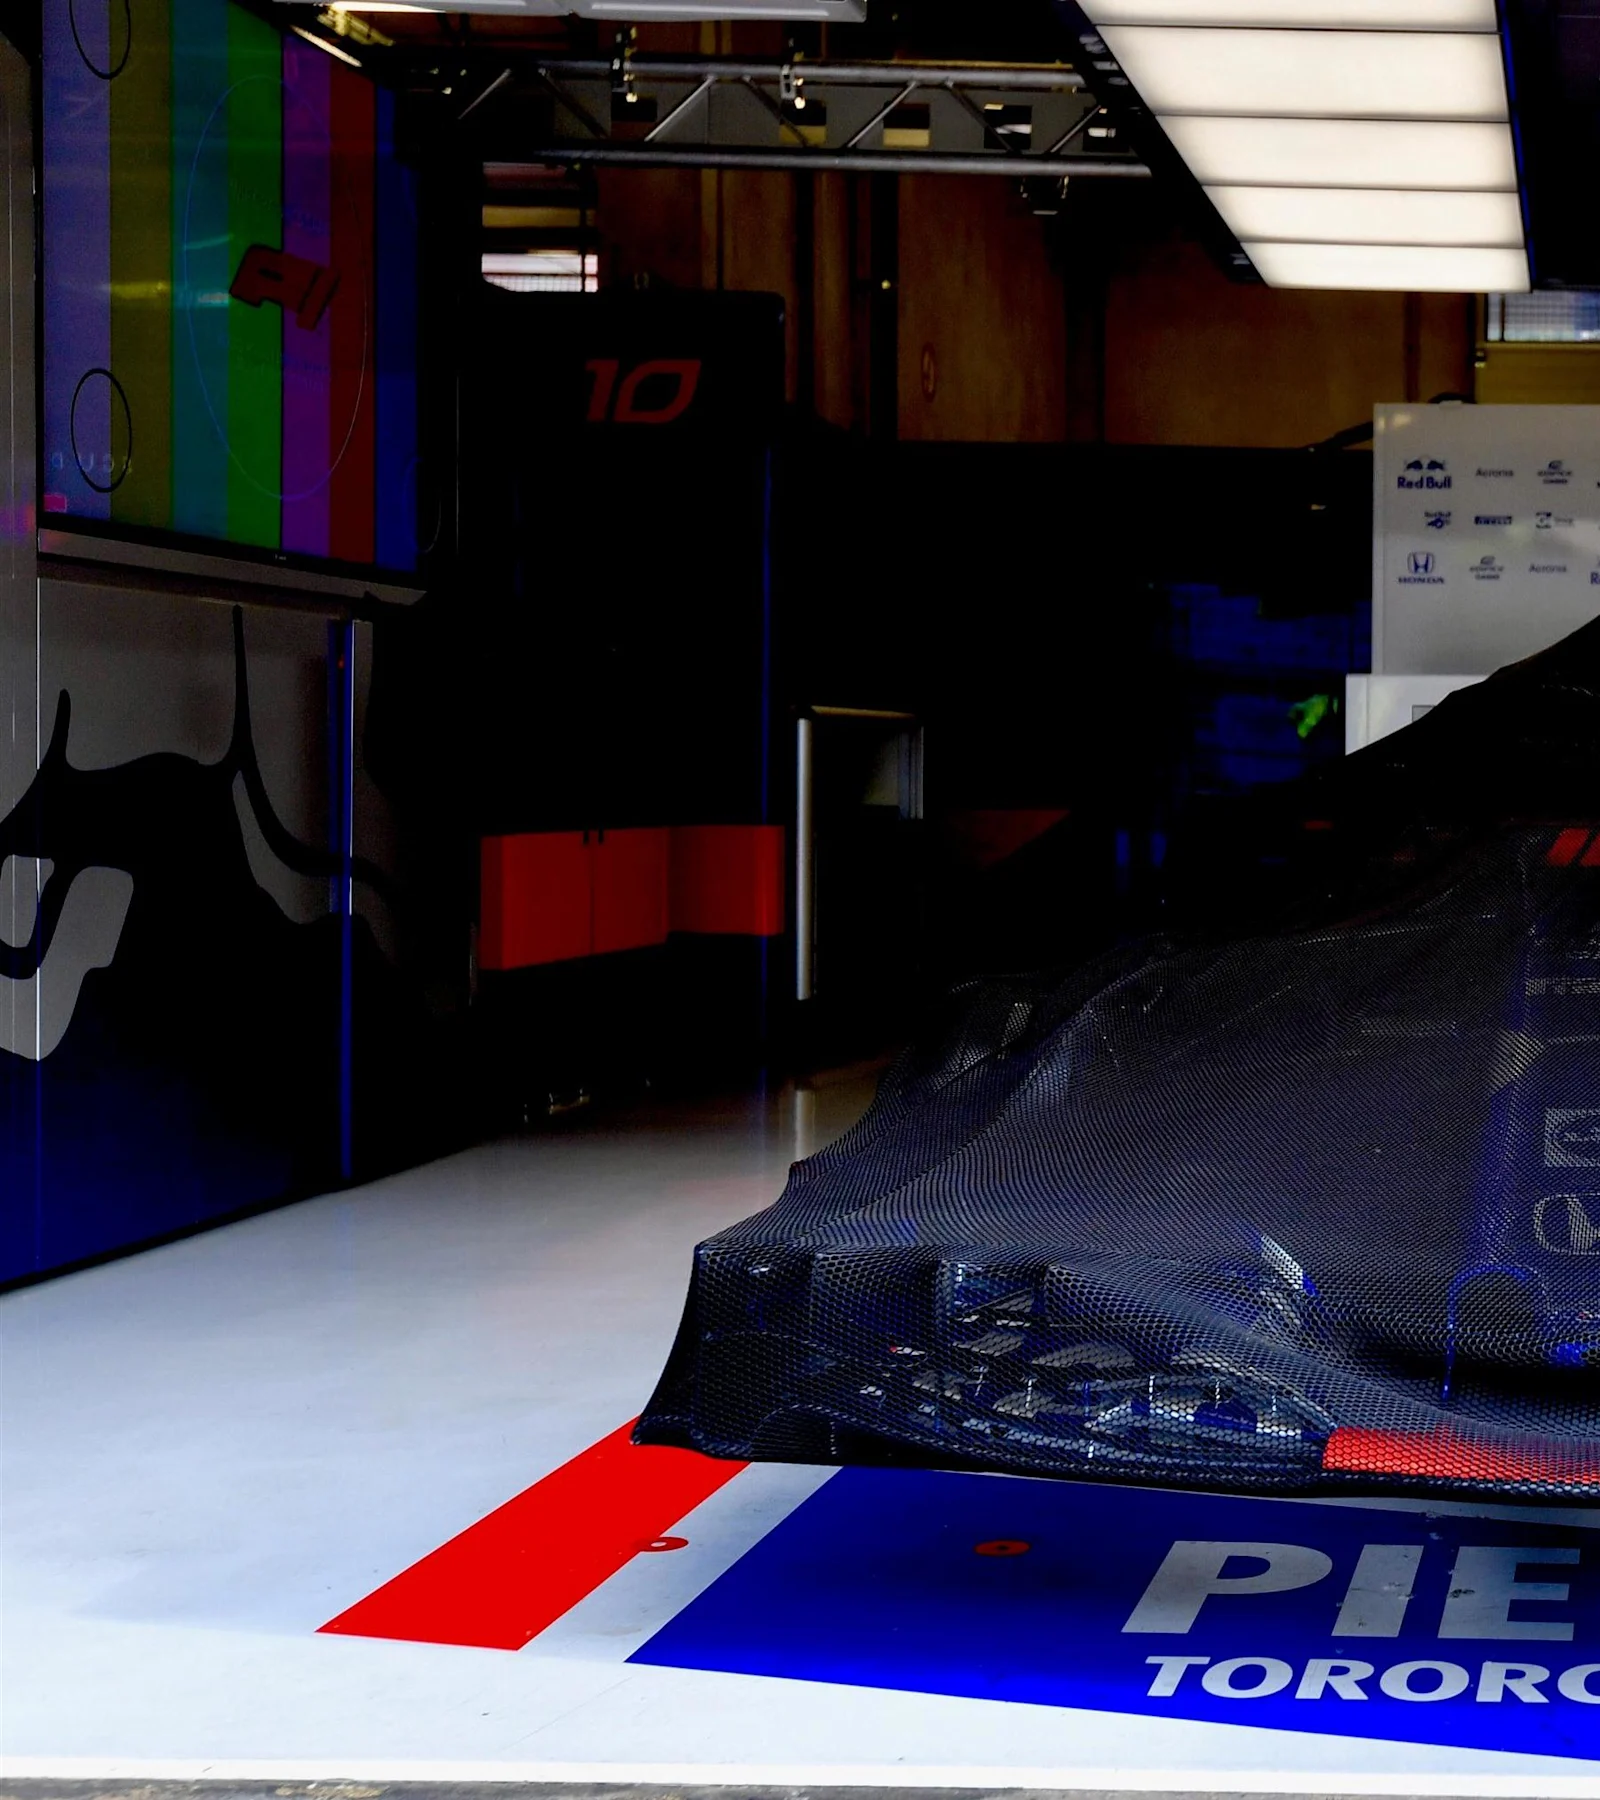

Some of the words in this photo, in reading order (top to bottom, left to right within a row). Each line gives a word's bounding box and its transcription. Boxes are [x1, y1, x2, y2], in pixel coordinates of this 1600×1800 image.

[584, 357, 702, 423] 10
[1397, 476, 1423, 489] Red
[1425, 476, 1452, 489] Bull
